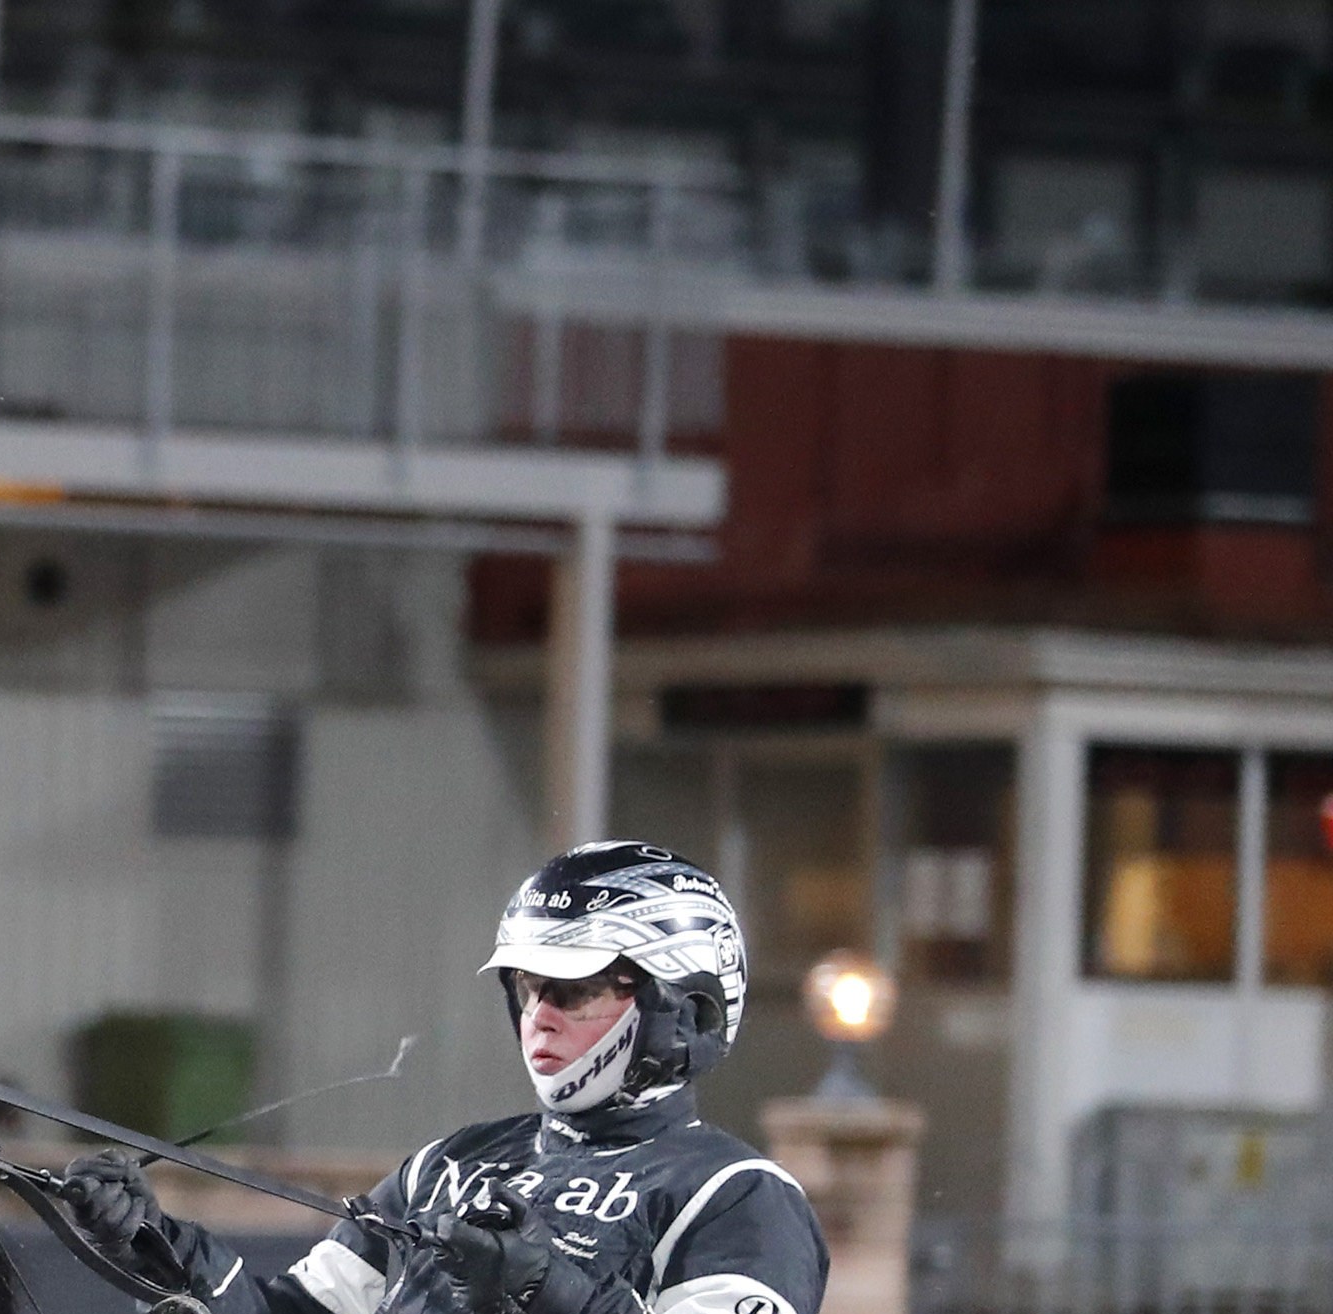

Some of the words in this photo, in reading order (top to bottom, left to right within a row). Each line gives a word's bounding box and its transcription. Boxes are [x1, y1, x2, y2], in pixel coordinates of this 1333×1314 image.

[548, 890, 571, 909] ab
[419, 1155, 544, 1216] Nia
[554, 1172, 638, 1223] ab
